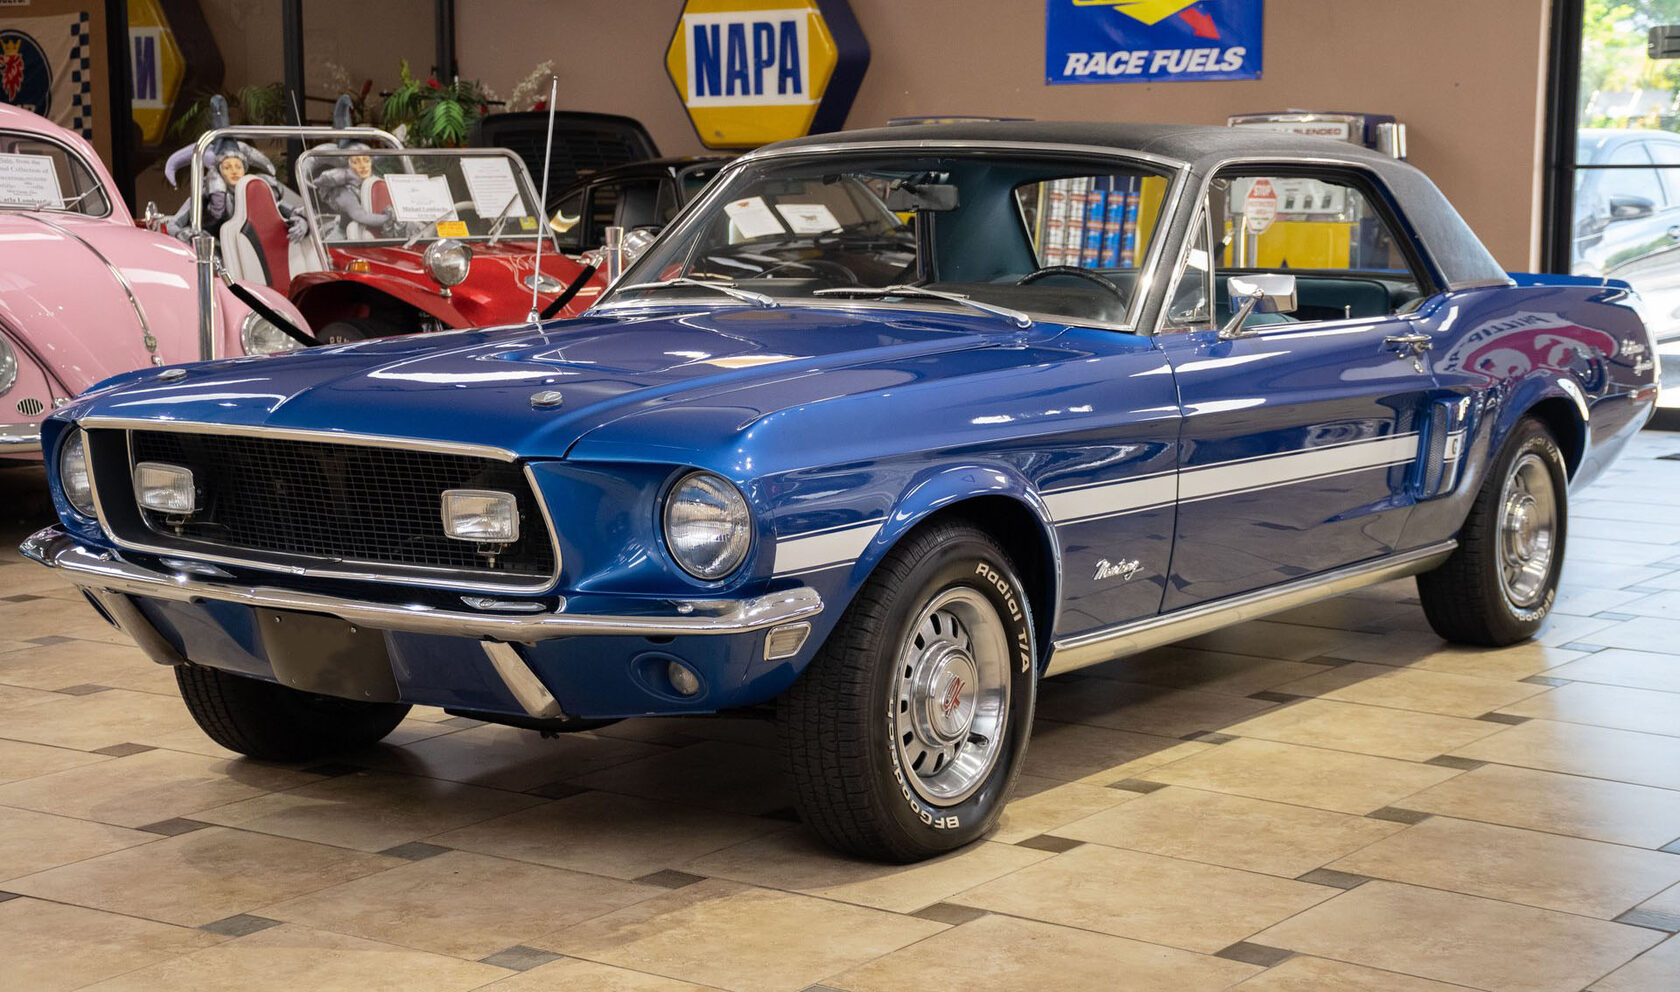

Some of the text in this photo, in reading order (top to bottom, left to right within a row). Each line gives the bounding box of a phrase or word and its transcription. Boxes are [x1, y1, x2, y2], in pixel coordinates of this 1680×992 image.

[693, 20, 802, 97] NAPA
[1063, 47, 1247, 76] RACE FUELS
[975, 562, 1030, 674] Radial T/A
